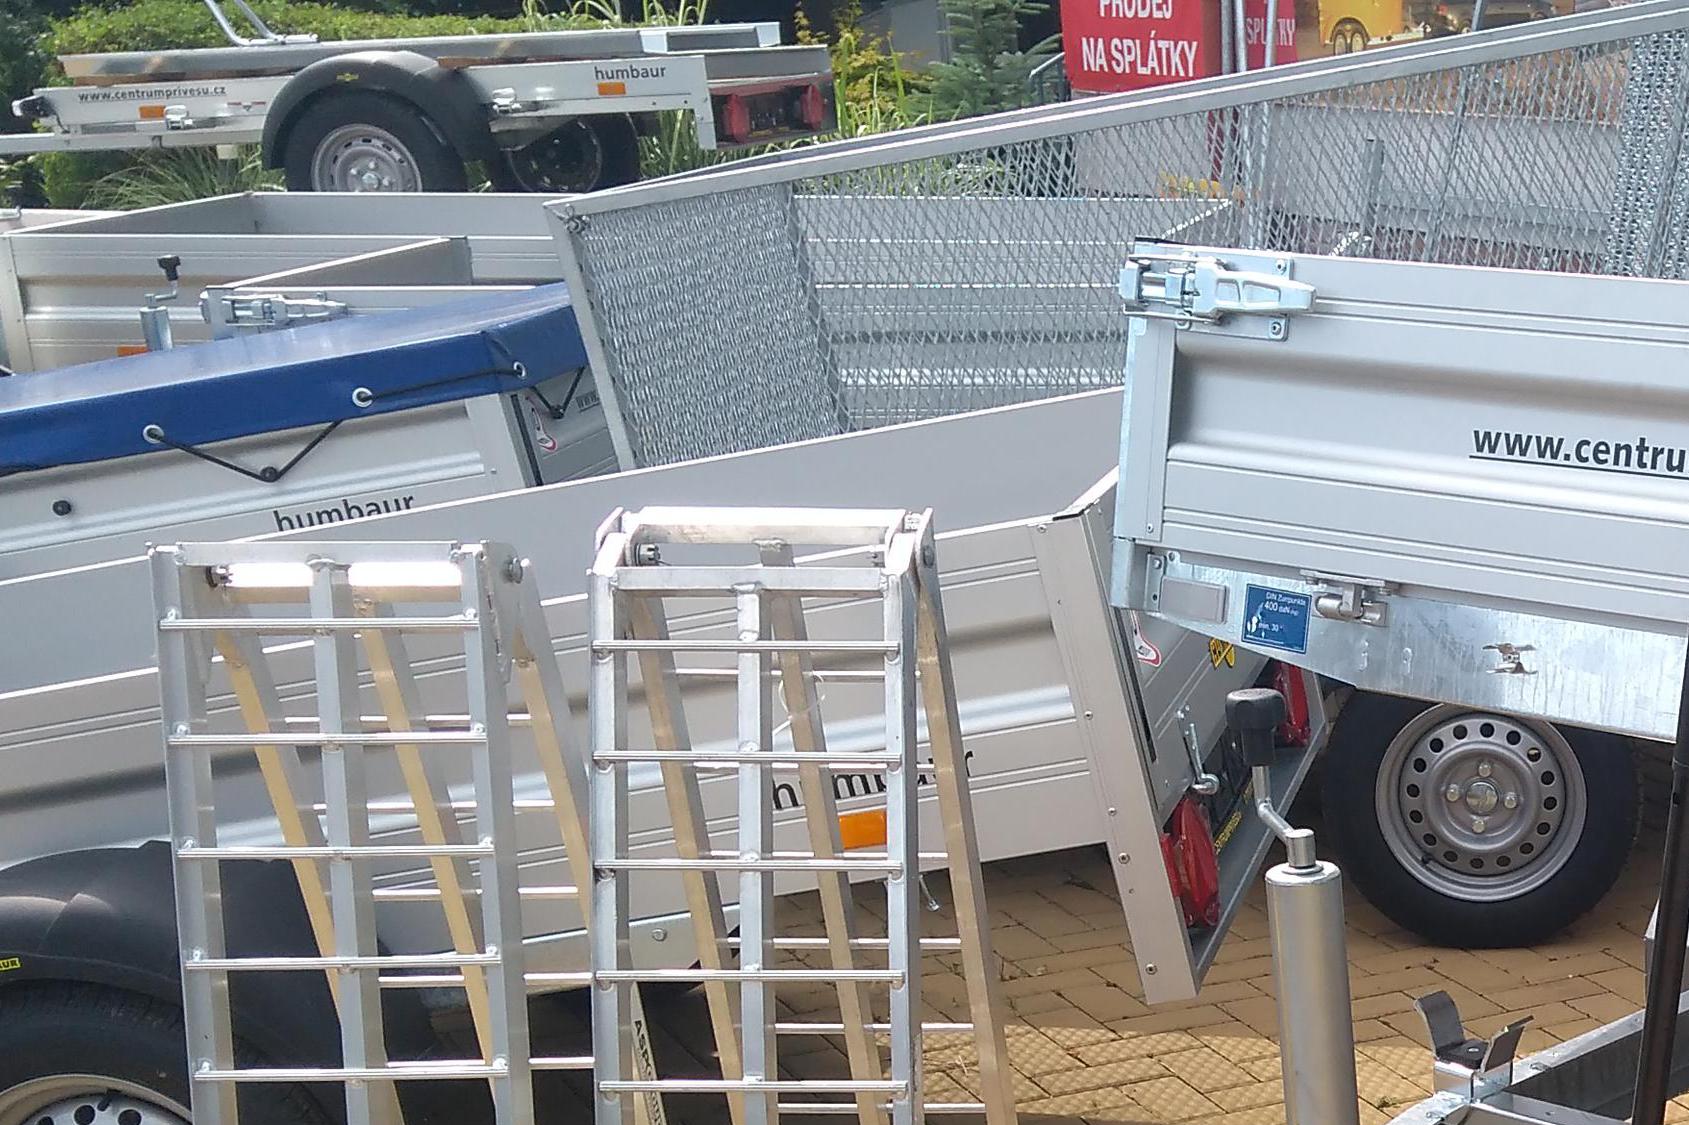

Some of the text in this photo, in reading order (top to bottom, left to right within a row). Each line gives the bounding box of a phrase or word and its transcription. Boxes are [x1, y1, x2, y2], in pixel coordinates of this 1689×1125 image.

[1081, 30, 1198, 77] NA SPLÁTKY
[594, 65, 666, 80] humbaur
[79, 86, 226, 102] www.centrumprivesu.cz
[273, 496, 414, 532] humbaur
[1264, 600, 1278, 611] 400
